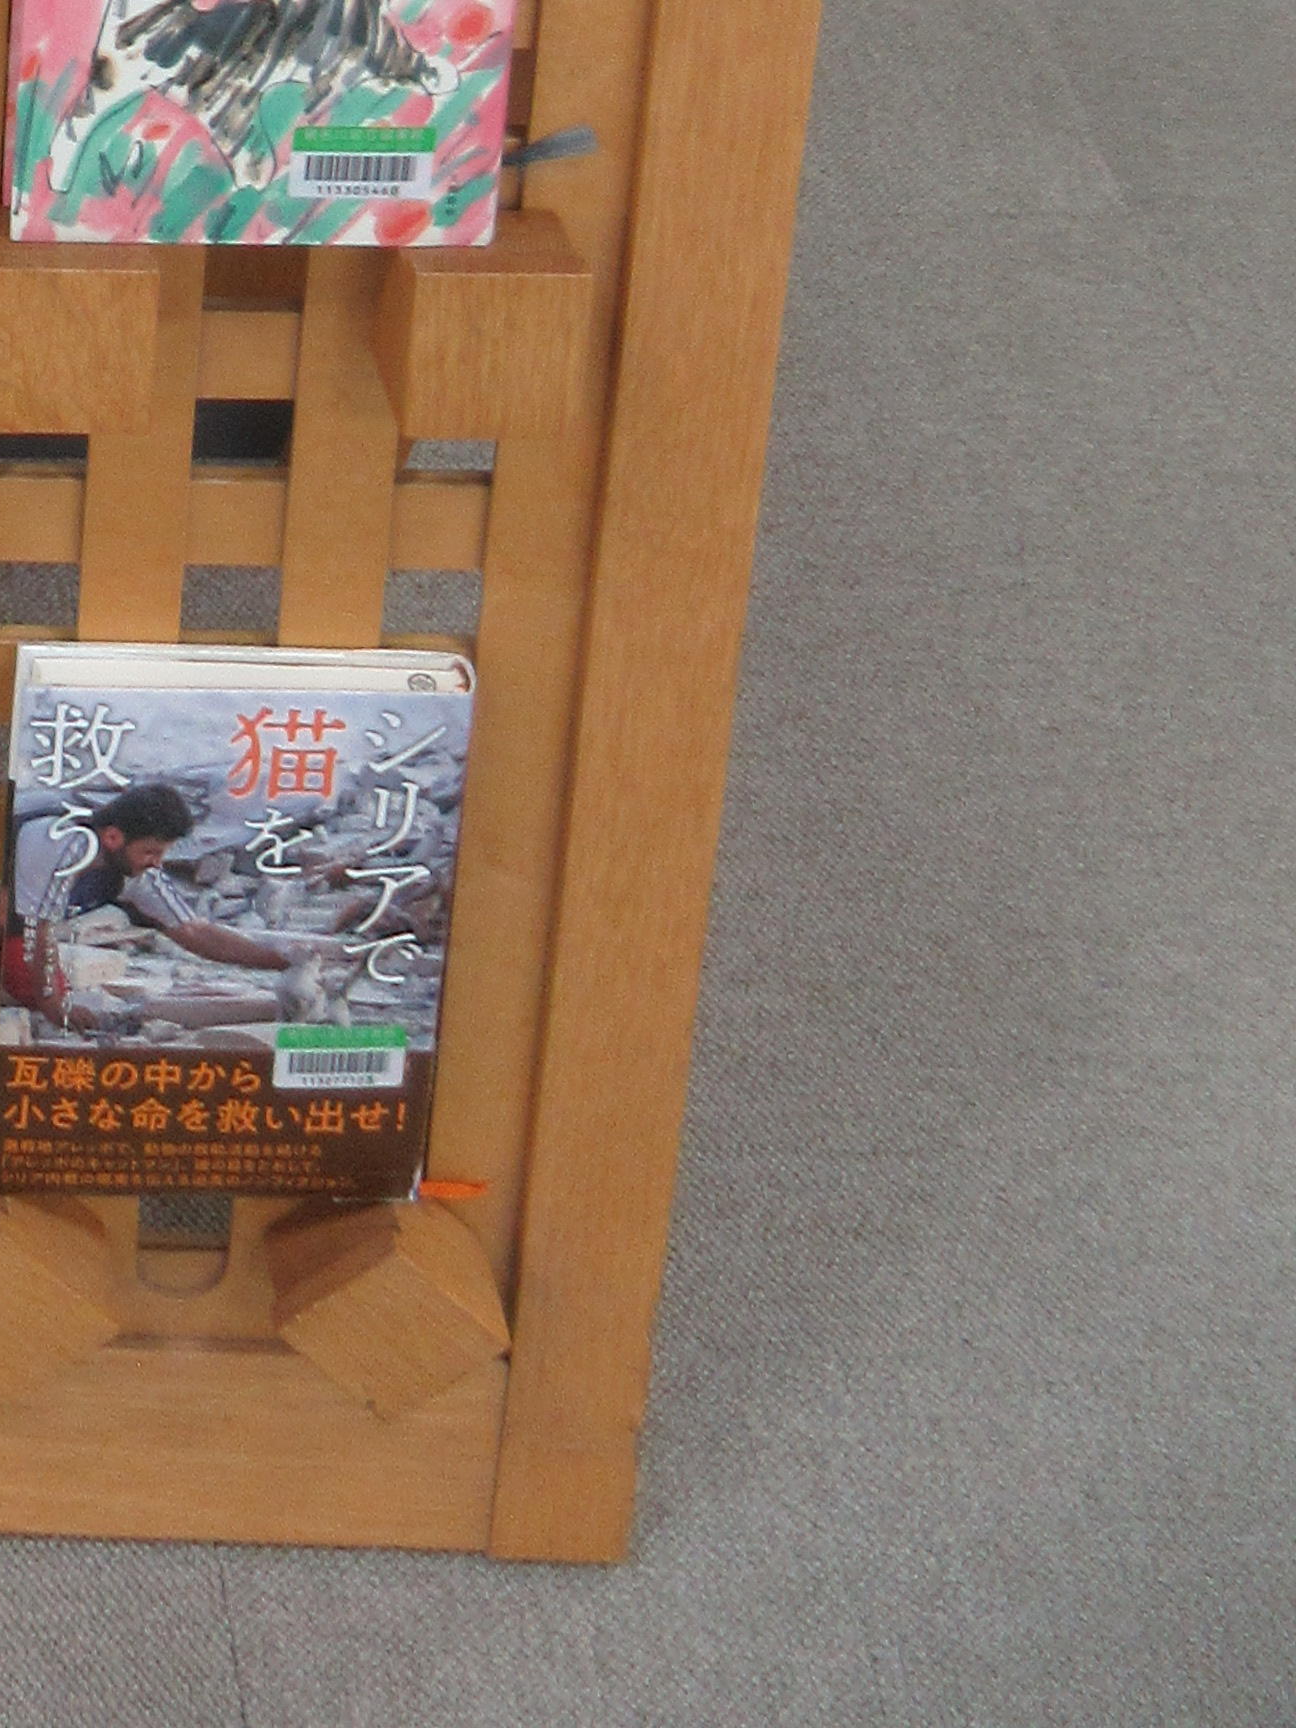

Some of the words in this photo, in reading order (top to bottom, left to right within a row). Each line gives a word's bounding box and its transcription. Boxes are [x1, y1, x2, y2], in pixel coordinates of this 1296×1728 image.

[29, 703, 136, 878] 救う
[226, 706, 346, 876] 猫を
[344, 710, 446, 985] シリアで
[2, 1099, 407, 1135] 小さな命を救い出せ！
[6, 1056, 263, 1094] 瓦礫の中から
